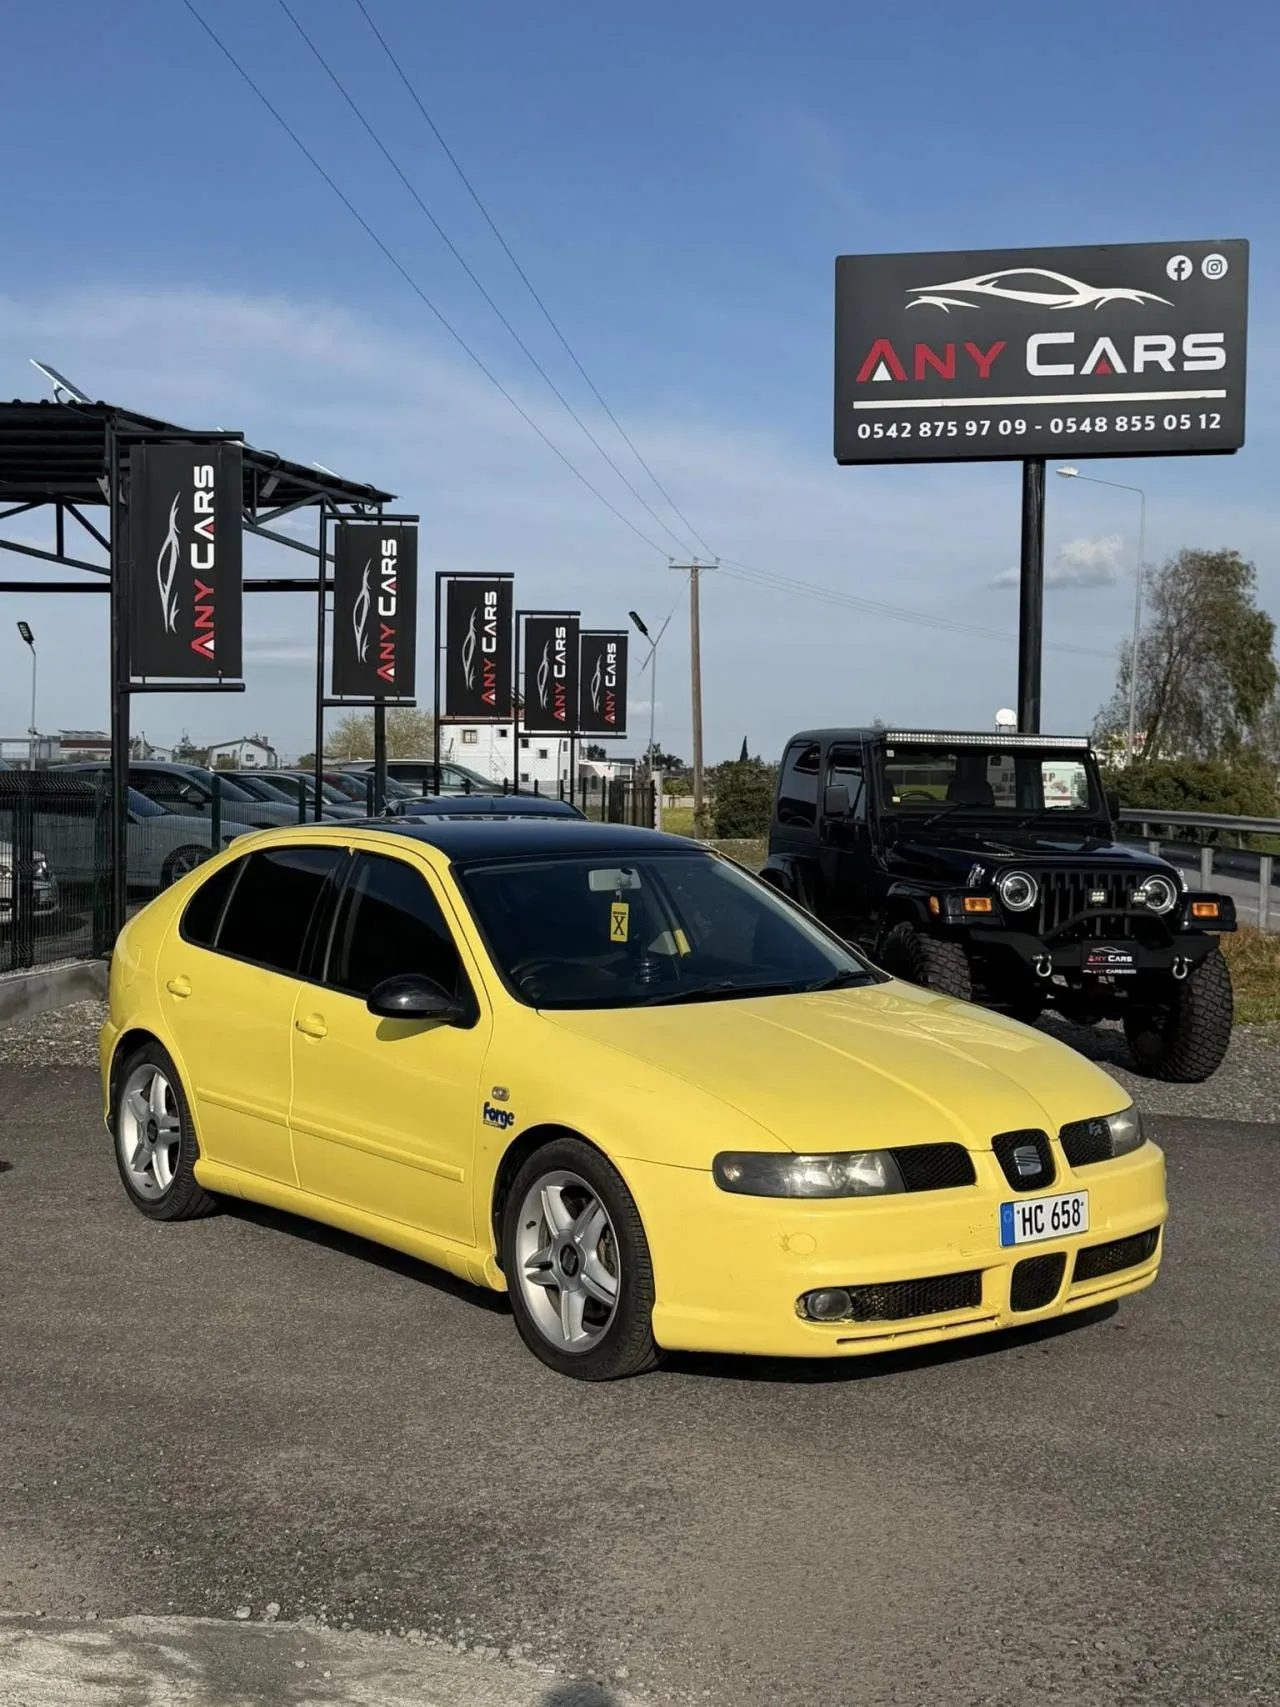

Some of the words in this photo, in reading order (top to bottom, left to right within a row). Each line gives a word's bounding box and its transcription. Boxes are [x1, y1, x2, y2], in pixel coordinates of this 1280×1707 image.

[856, 339, 1007, 382] ANY
[1026, 332, 1227, 376] CARS
[857, 422, 912, 439] 0542
[919, 421, 958, 437] 875
[965, 420, 991, 436] 97
[999, 419, 1027, 435] 09
[1050, 417, 1108, 434] 0548
[1115, 415, 1155, 432] 855
[1163, 414, 1191, 431] 05
[1199, 413, 1222, 430] 12
[190, 465, 215, 570] CARS
[378, 538, 397, 617] CARS
[189, 578, 215, 660] ANY
[482, 591, 497, 653] CARS
[376, 623, 396, 683] ANY
[553, 626, 566, 679] CARS
[605, 642, 617, 687] CARS
[481, 658, 497, 706] ANY
[553, 682, 566, 722] ANY
[604, 690, 616, 725] ANY
[613, 915, 626, 936] X
[1108, 954, 1133, 963] CARS
[1022, 1204, 1045, 1237] HC
[1051, 1198, 1081, 1231] 658
